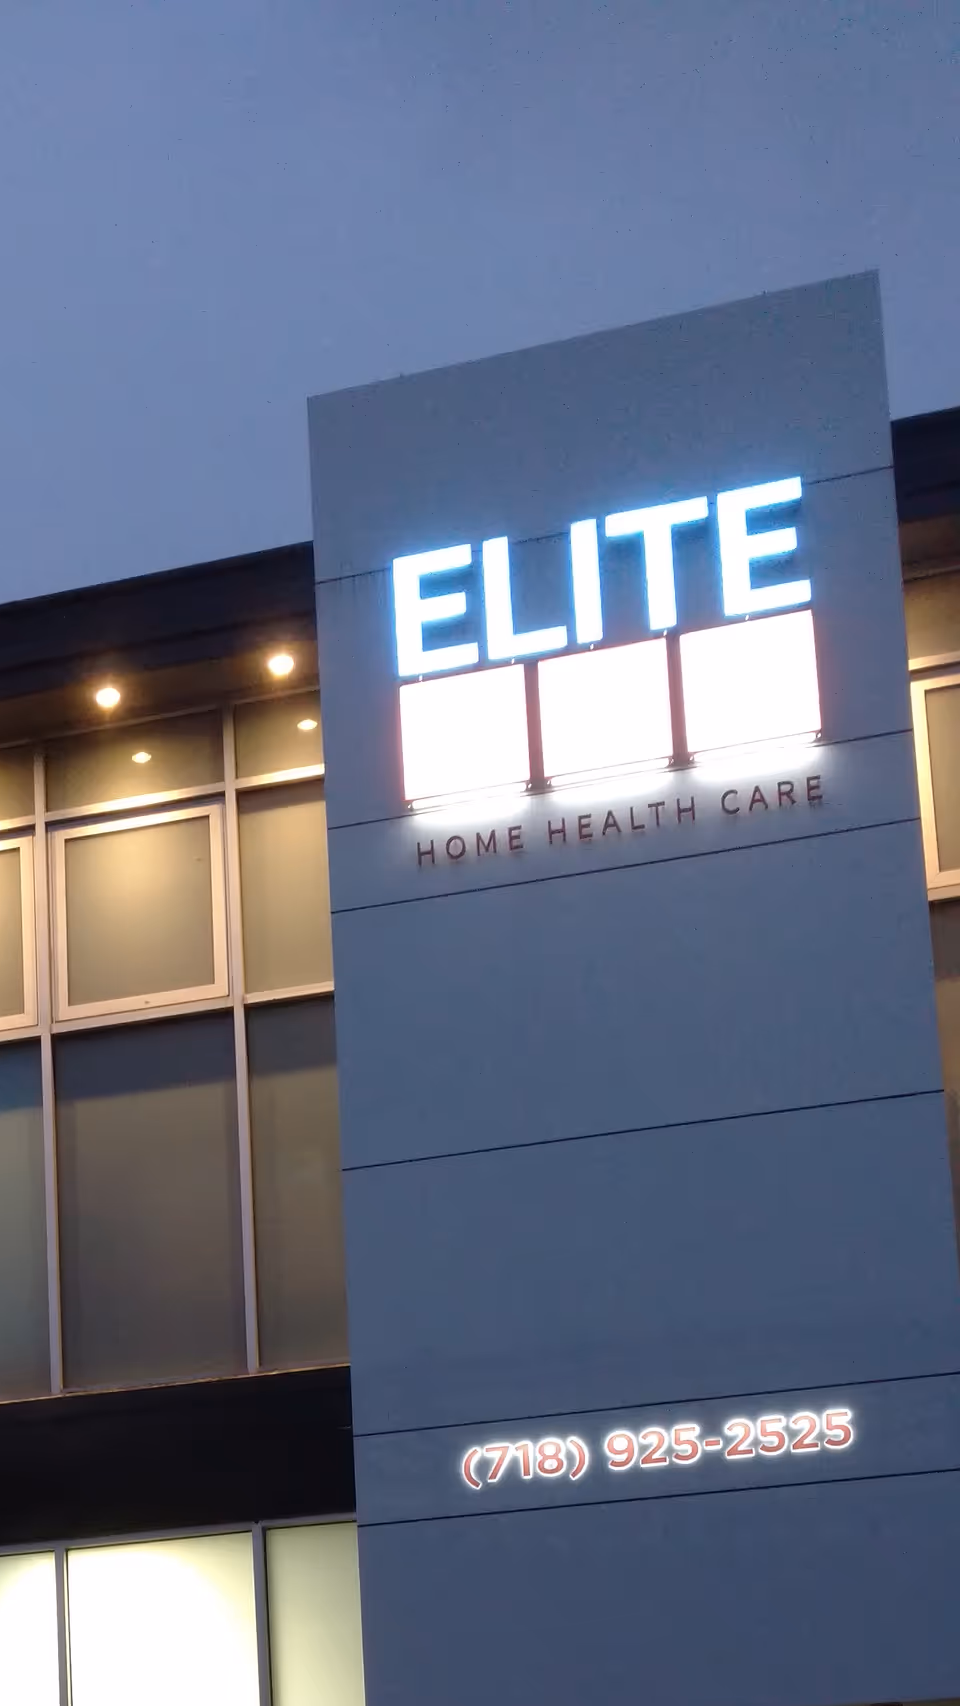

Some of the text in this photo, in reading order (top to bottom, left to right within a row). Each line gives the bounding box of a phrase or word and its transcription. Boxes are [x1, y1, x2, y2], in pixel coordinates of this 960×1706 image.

[392, 475, 813, 679] ELITE
[416, 774, 825, 867] HOME HEALTH CARE
[462, 1408, 855, 1490] (718) 925-2525
